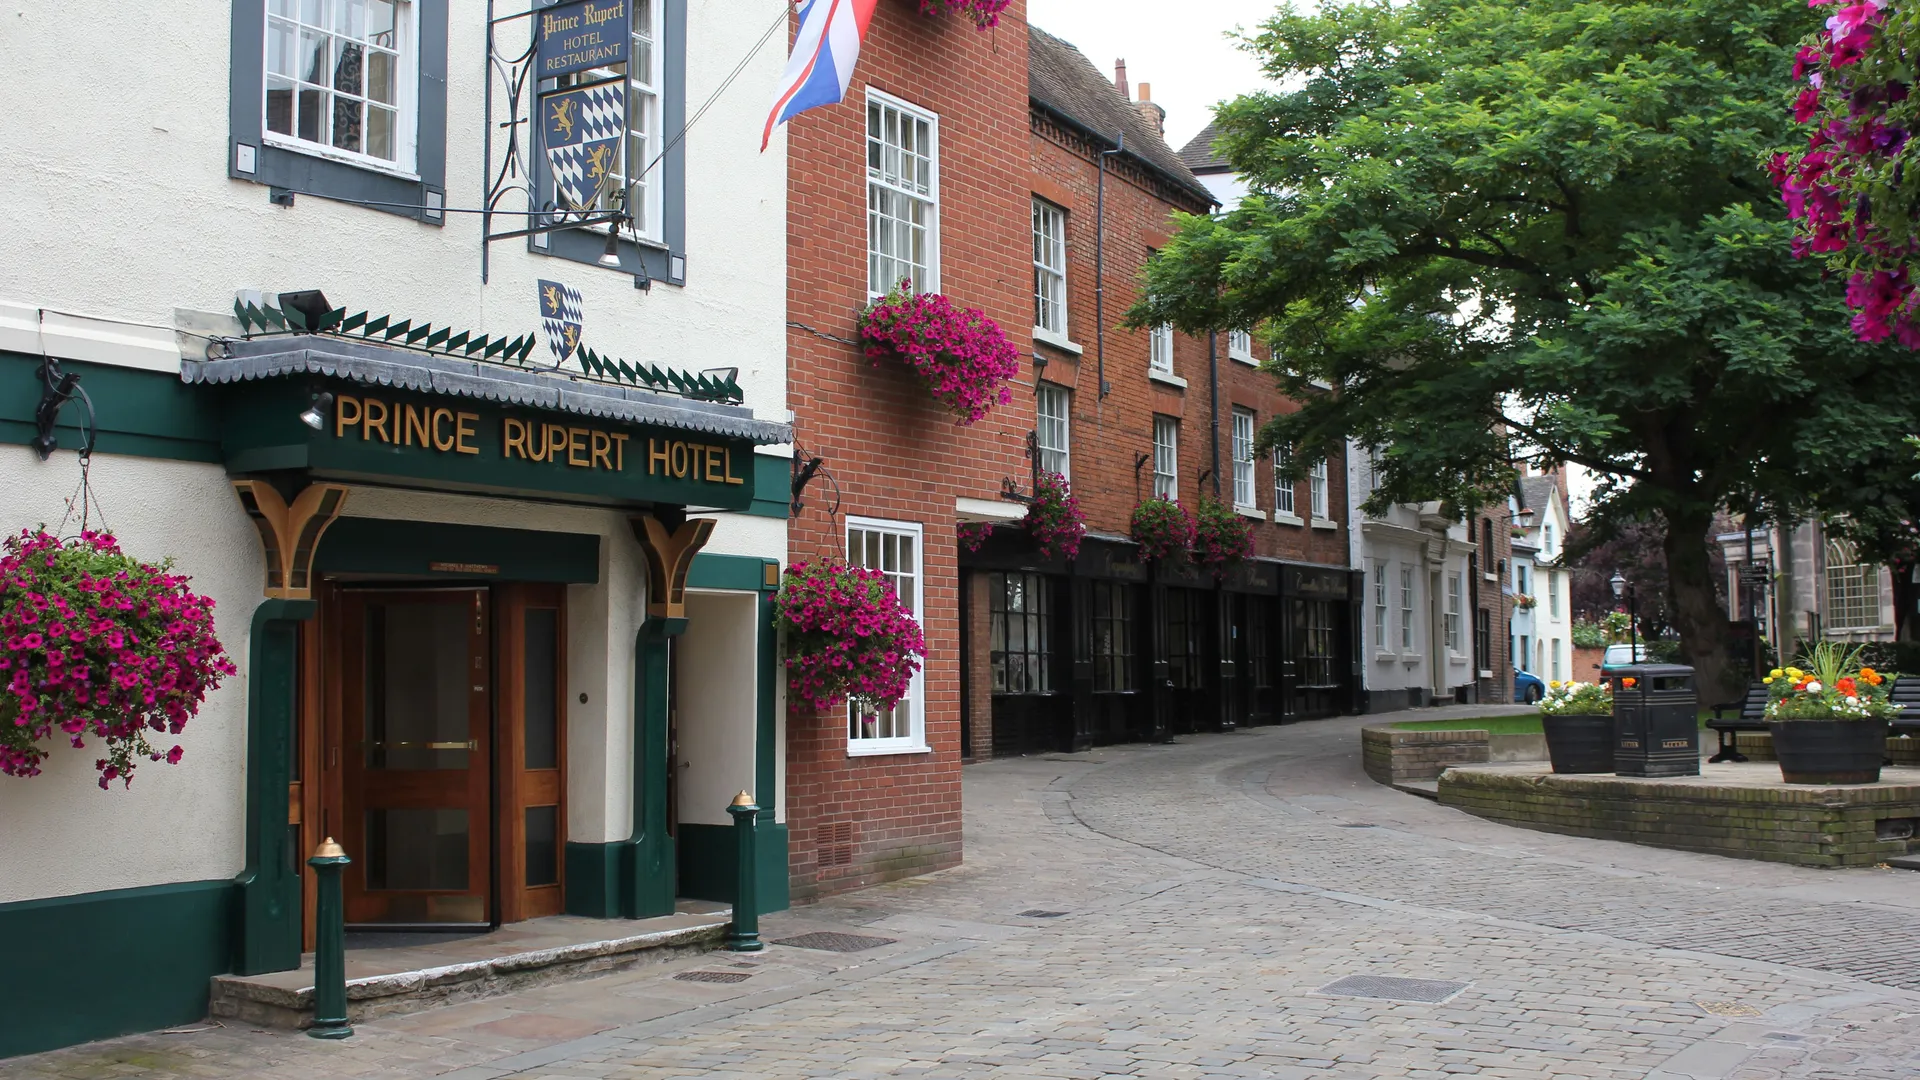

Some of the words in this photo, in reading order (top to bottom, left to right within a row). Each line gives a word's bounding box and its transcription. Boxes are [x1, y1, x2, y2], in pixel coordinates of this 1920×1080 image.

[543, 14, 579, 41] Prince
[584, 0, 624, 26] Rupert
[546, 43, 621, 70] RESTAURANT
[563, 32, 603, 50] HOTEL
[336, 395, 479, 454] PRINCE
[504, 417, 629, 471] RUPERT
[649, 438, 743, 484] HOTEL
